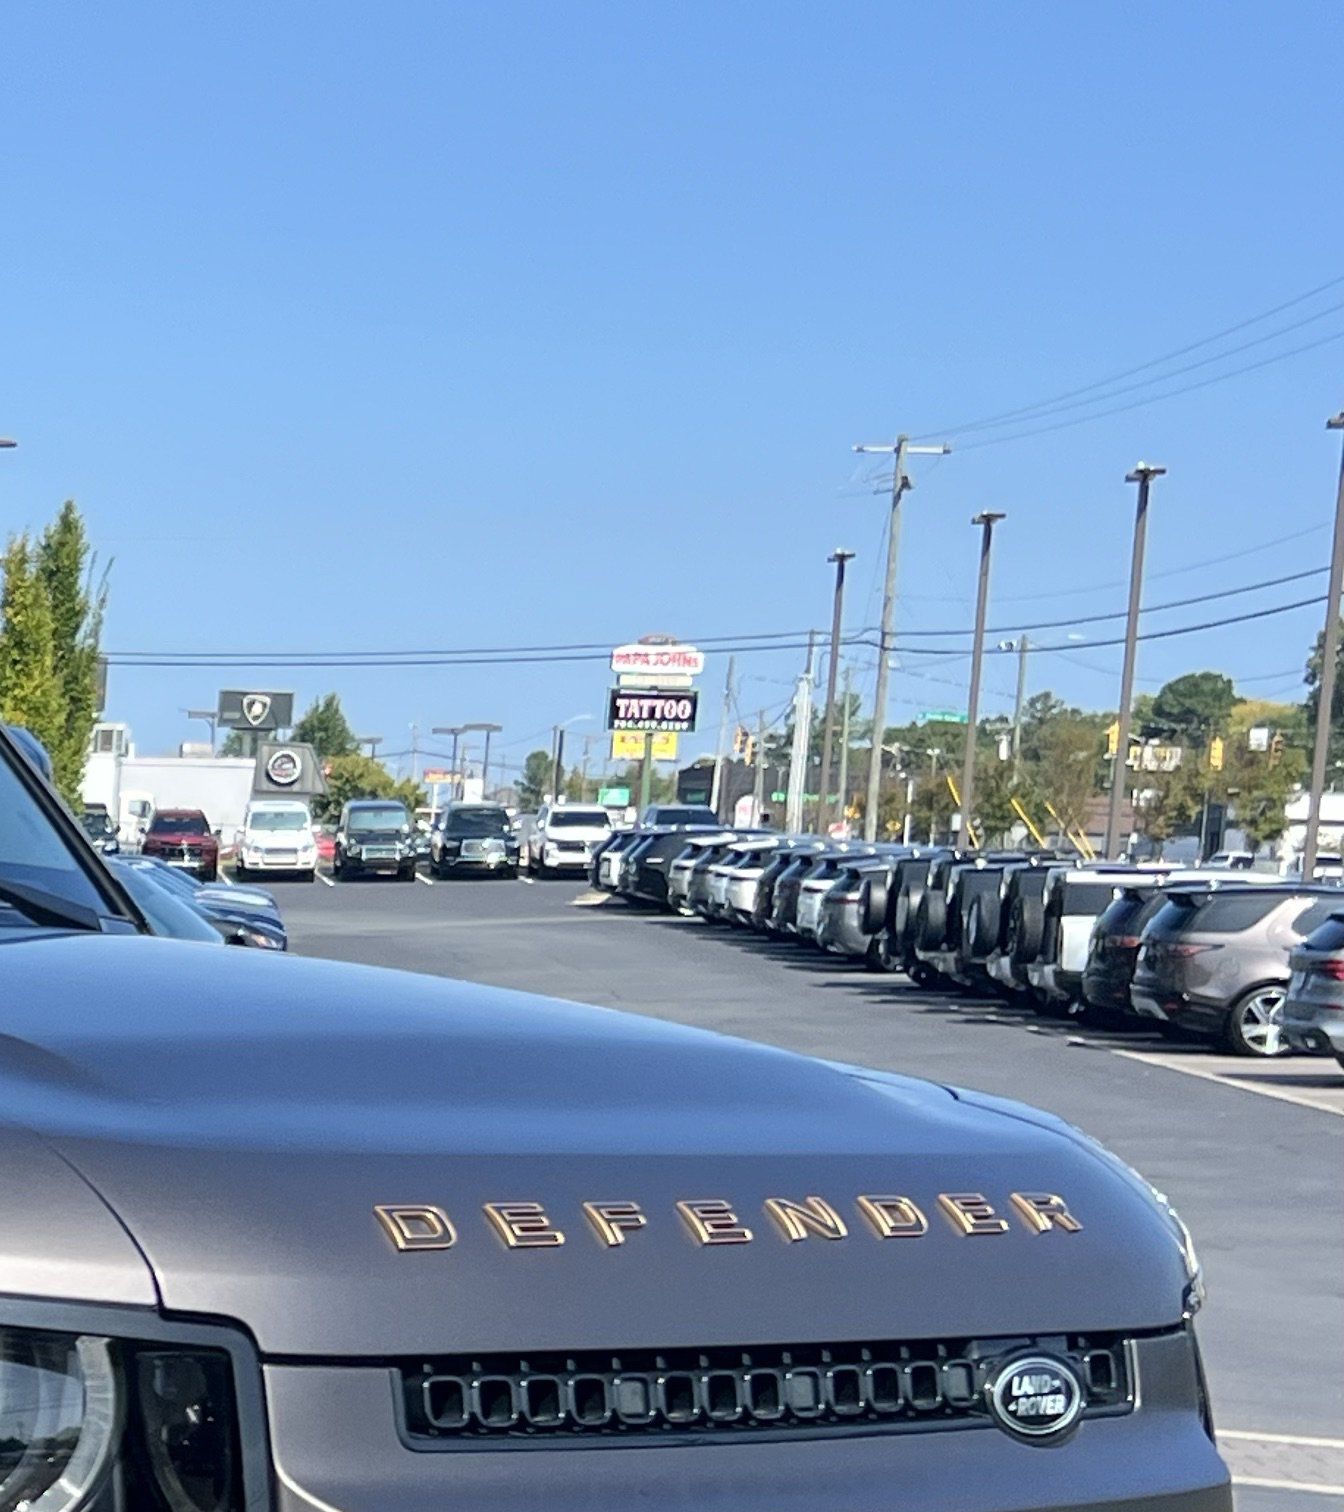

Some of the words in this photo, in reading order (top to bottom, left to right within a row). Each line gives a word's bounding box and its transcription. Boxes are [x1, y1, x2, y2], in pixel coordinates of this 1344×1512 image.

[615, 697, 692, 719] TATTOO
[373, 1193, 1083, 1252] DEFENDER
[1012, 1375, 1053, 1397] LAND
[1016, 1394, 1068, 1417] ROVER
